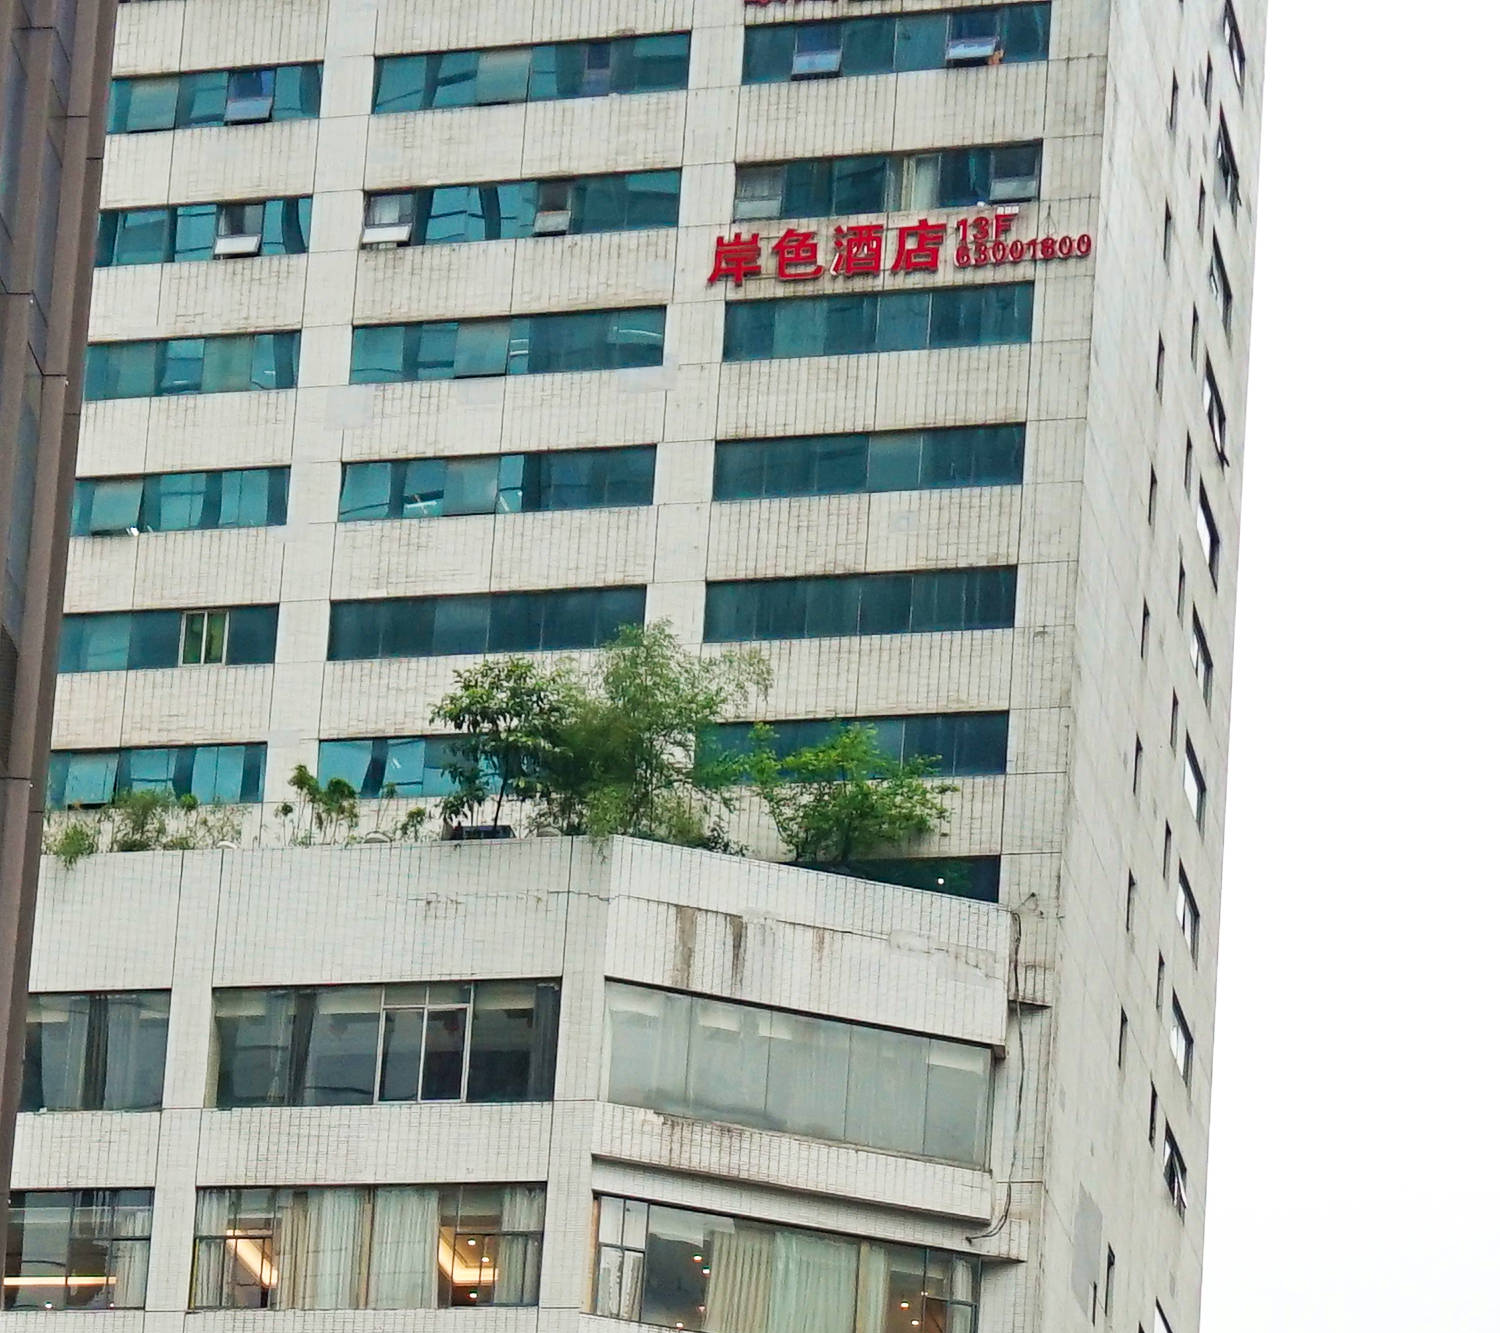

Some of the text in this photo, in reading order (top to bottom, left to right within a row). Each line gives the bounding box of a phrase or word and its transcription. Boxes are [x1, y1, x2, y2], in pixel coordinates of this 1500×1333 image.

[956, 213, 1019, 243] 13F
[707, 219, 948, 287] 岸色酒店
[955, 234, 1092, 268] 63001800
